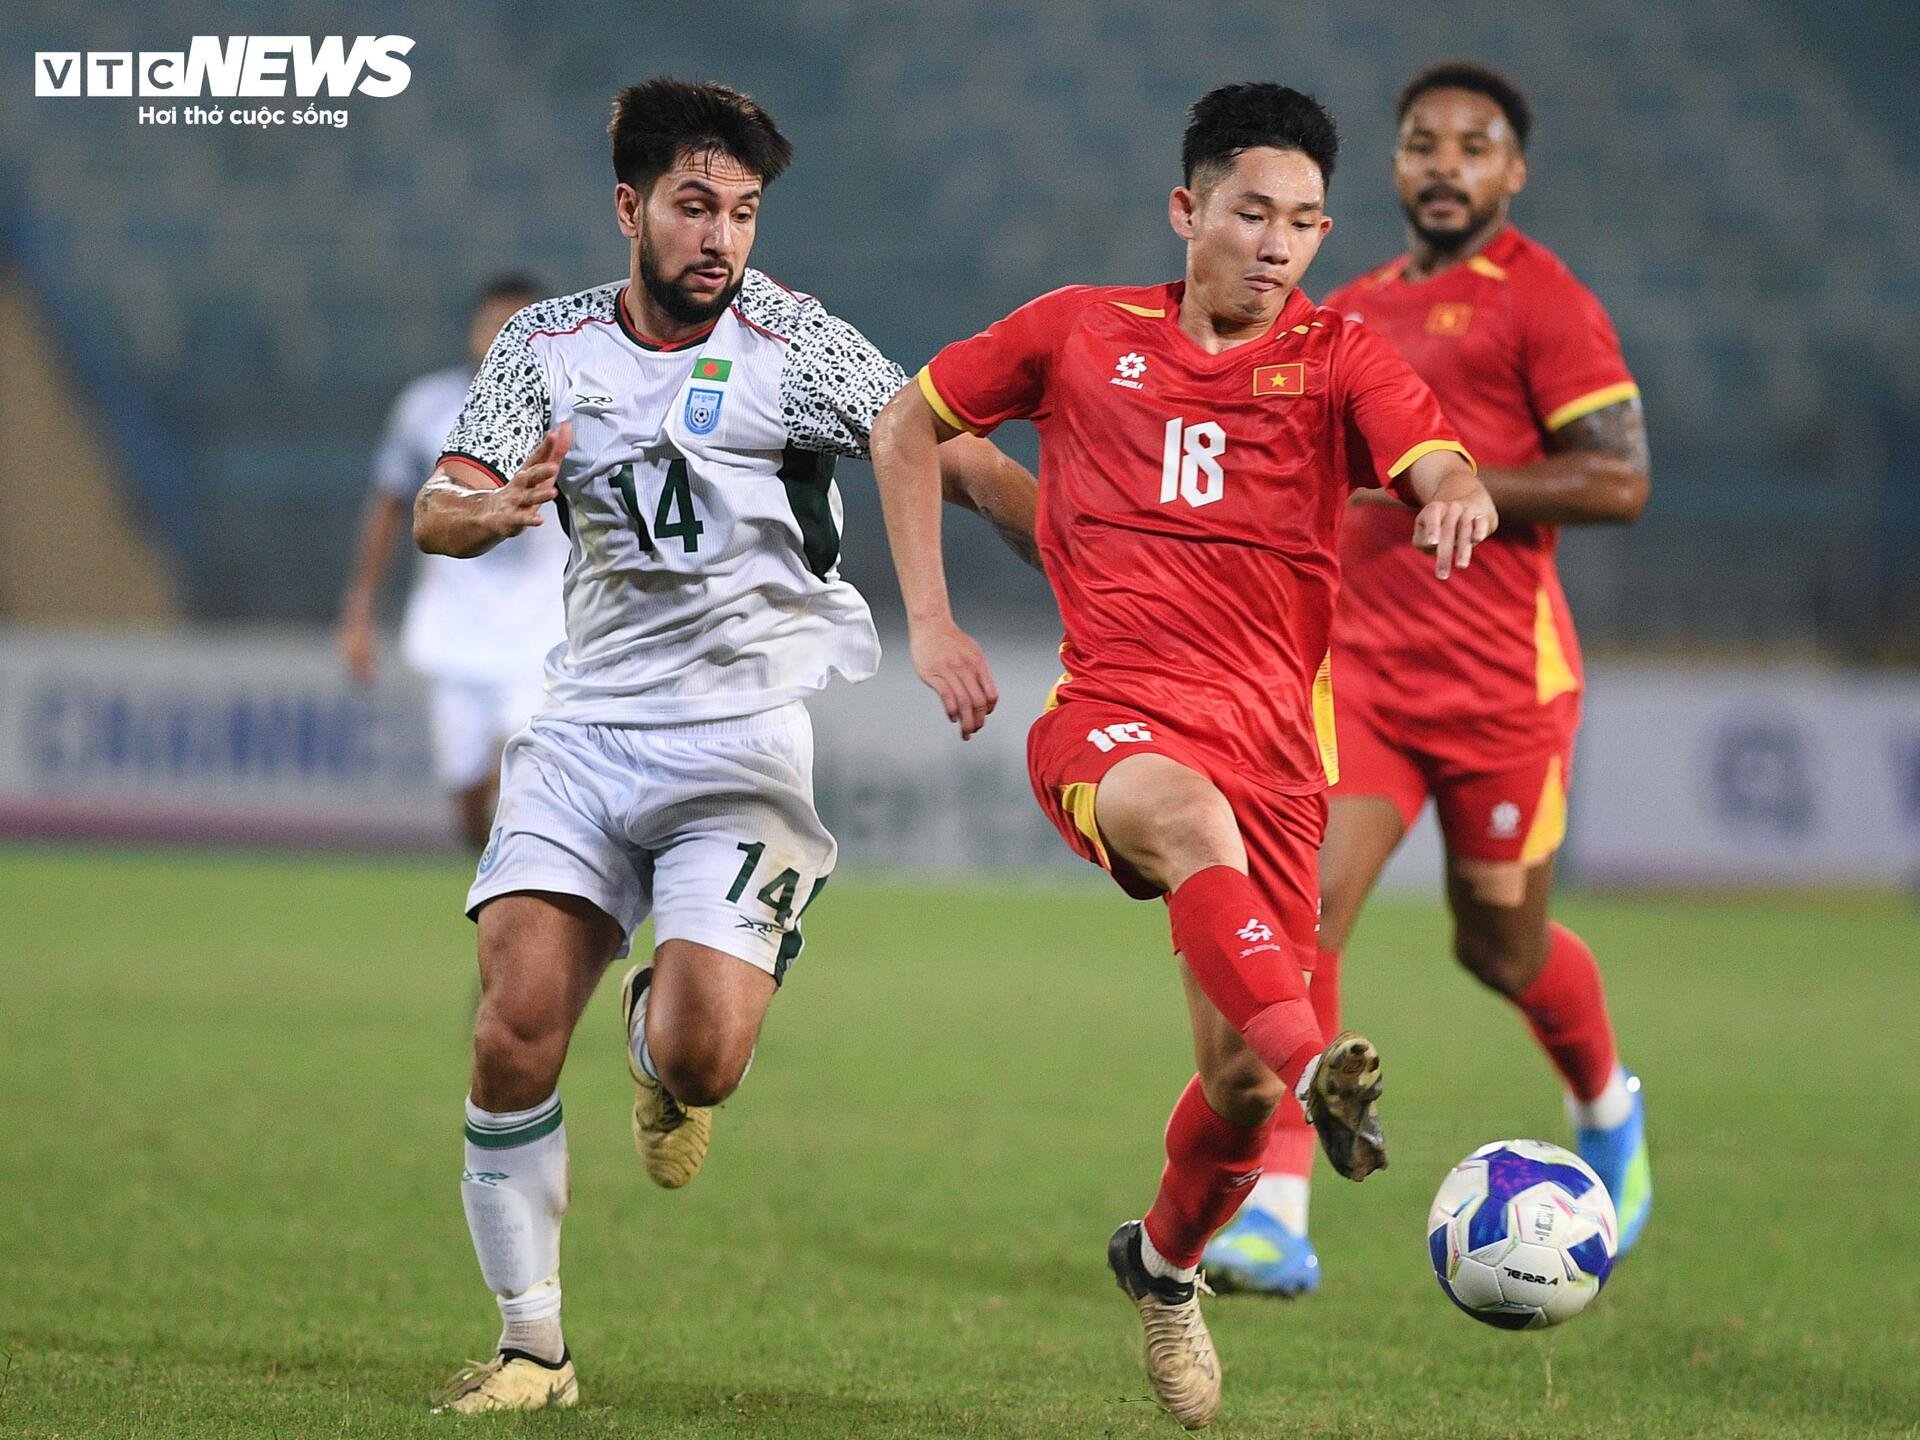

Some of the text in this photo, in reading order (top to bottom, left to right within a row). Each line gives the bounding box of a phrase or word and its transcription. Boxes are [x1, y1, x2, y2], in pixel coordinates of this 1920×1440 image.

[608, 457, 704, 554] 14
[1160, 416, 1227, 508] 18
[725, 840, 801, 929] 14
[1503, 1266, 1559, 1286] TERRA
